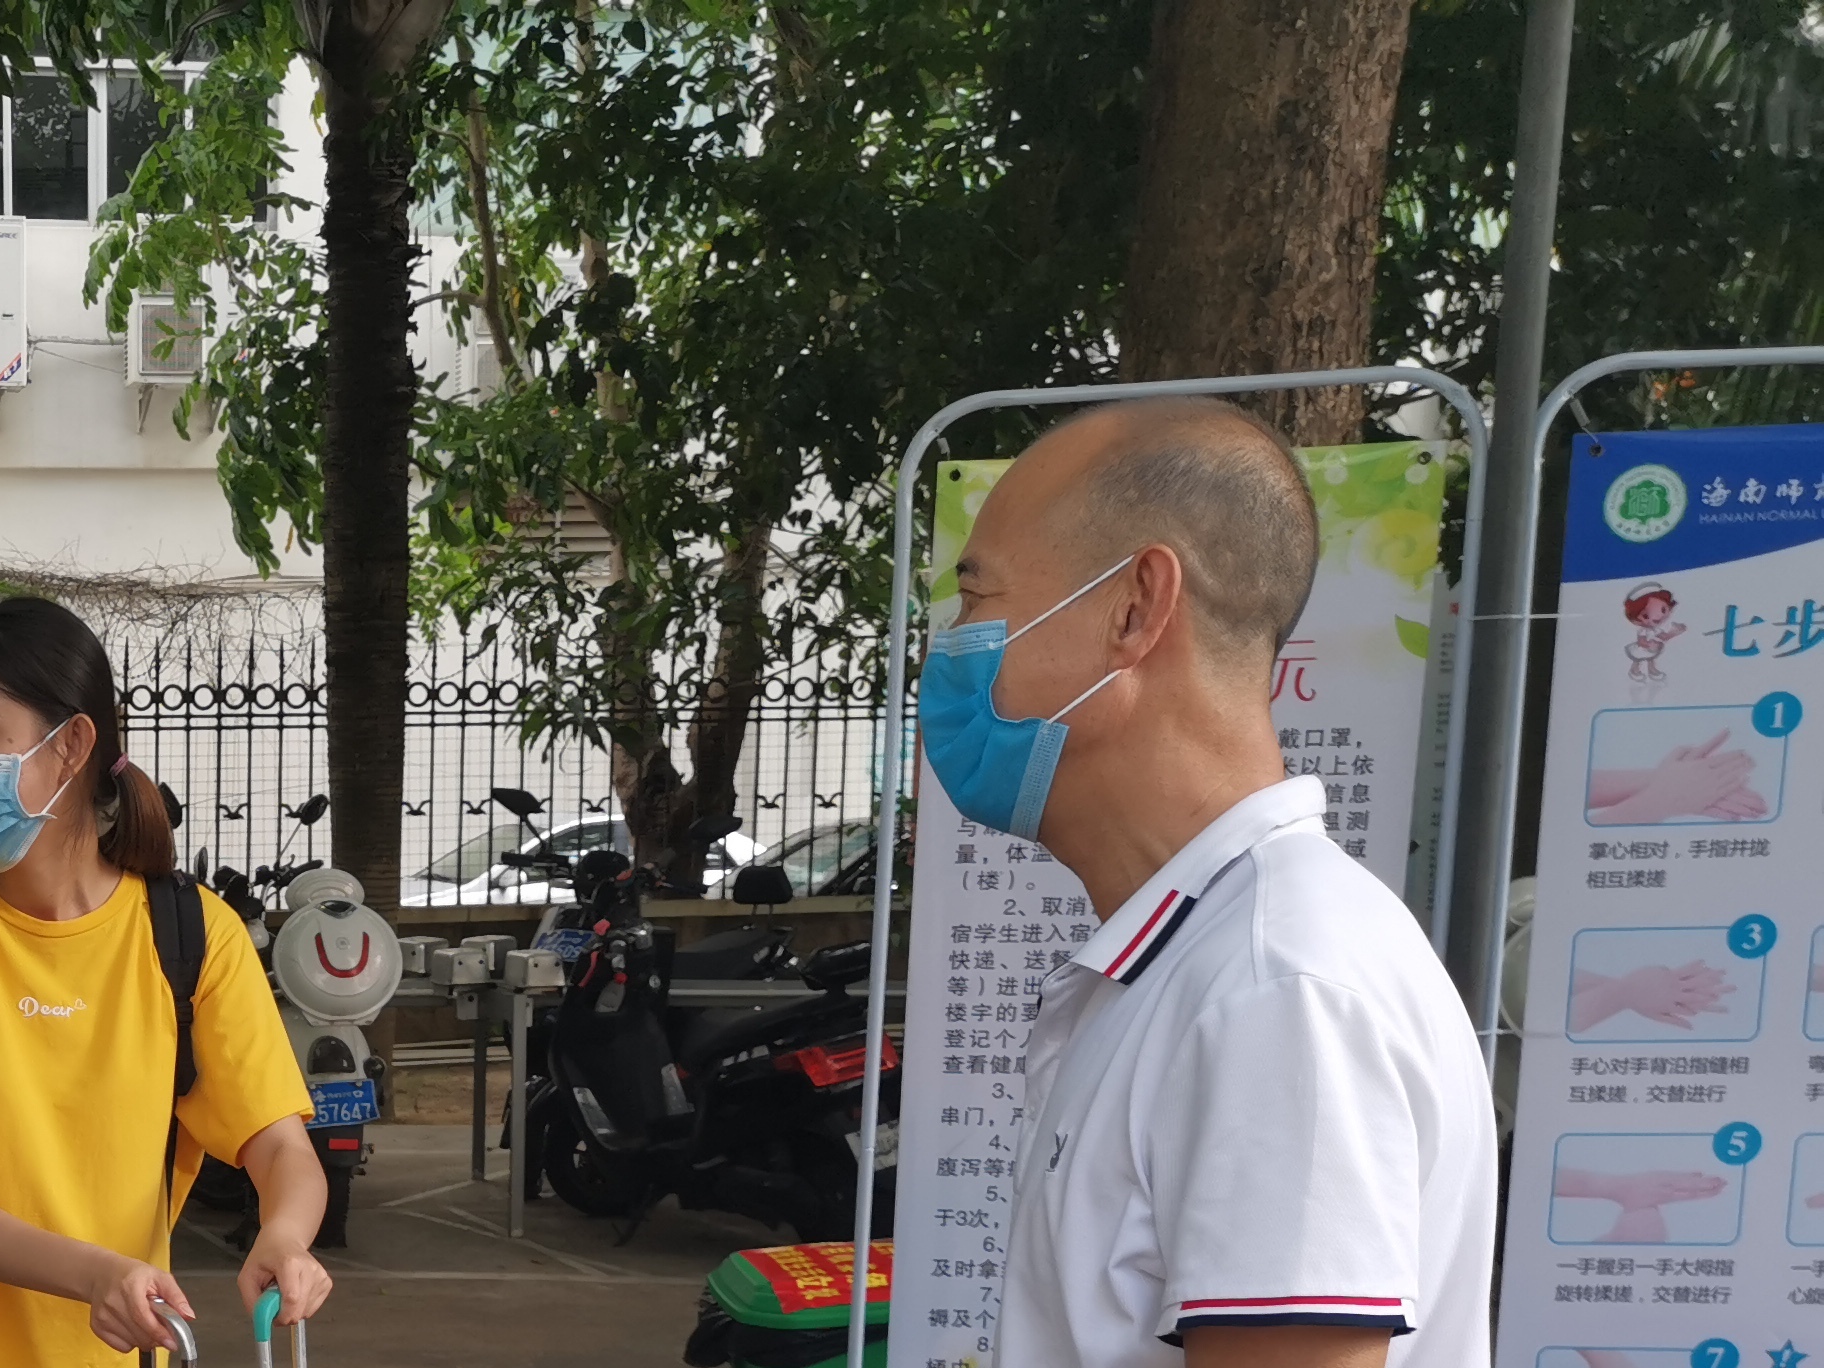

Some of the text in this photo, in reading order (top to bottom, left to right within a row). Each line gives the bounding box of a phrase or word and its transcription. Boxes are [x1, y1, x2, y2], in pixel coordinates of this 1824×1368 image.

[1702, 599, 1824, 659] 七步
[1270, 640, 1318, 702] 元
[1769, 702, 1786, 729] 1
[1325, 783, 1372, 804] 信息
[1003, 895, 1097, 917] 2、取消
[950, 922, 1102, 944] 宿学生进入宿
[1743, 923, 1761, 949] 3
[18, 996, 74, 1017] Dear
[309, 1102, 371, 1124] 57647
[1727, 1131, 1746, 1156] 5
[931, 1258, 1007, 1279] 及时拿
